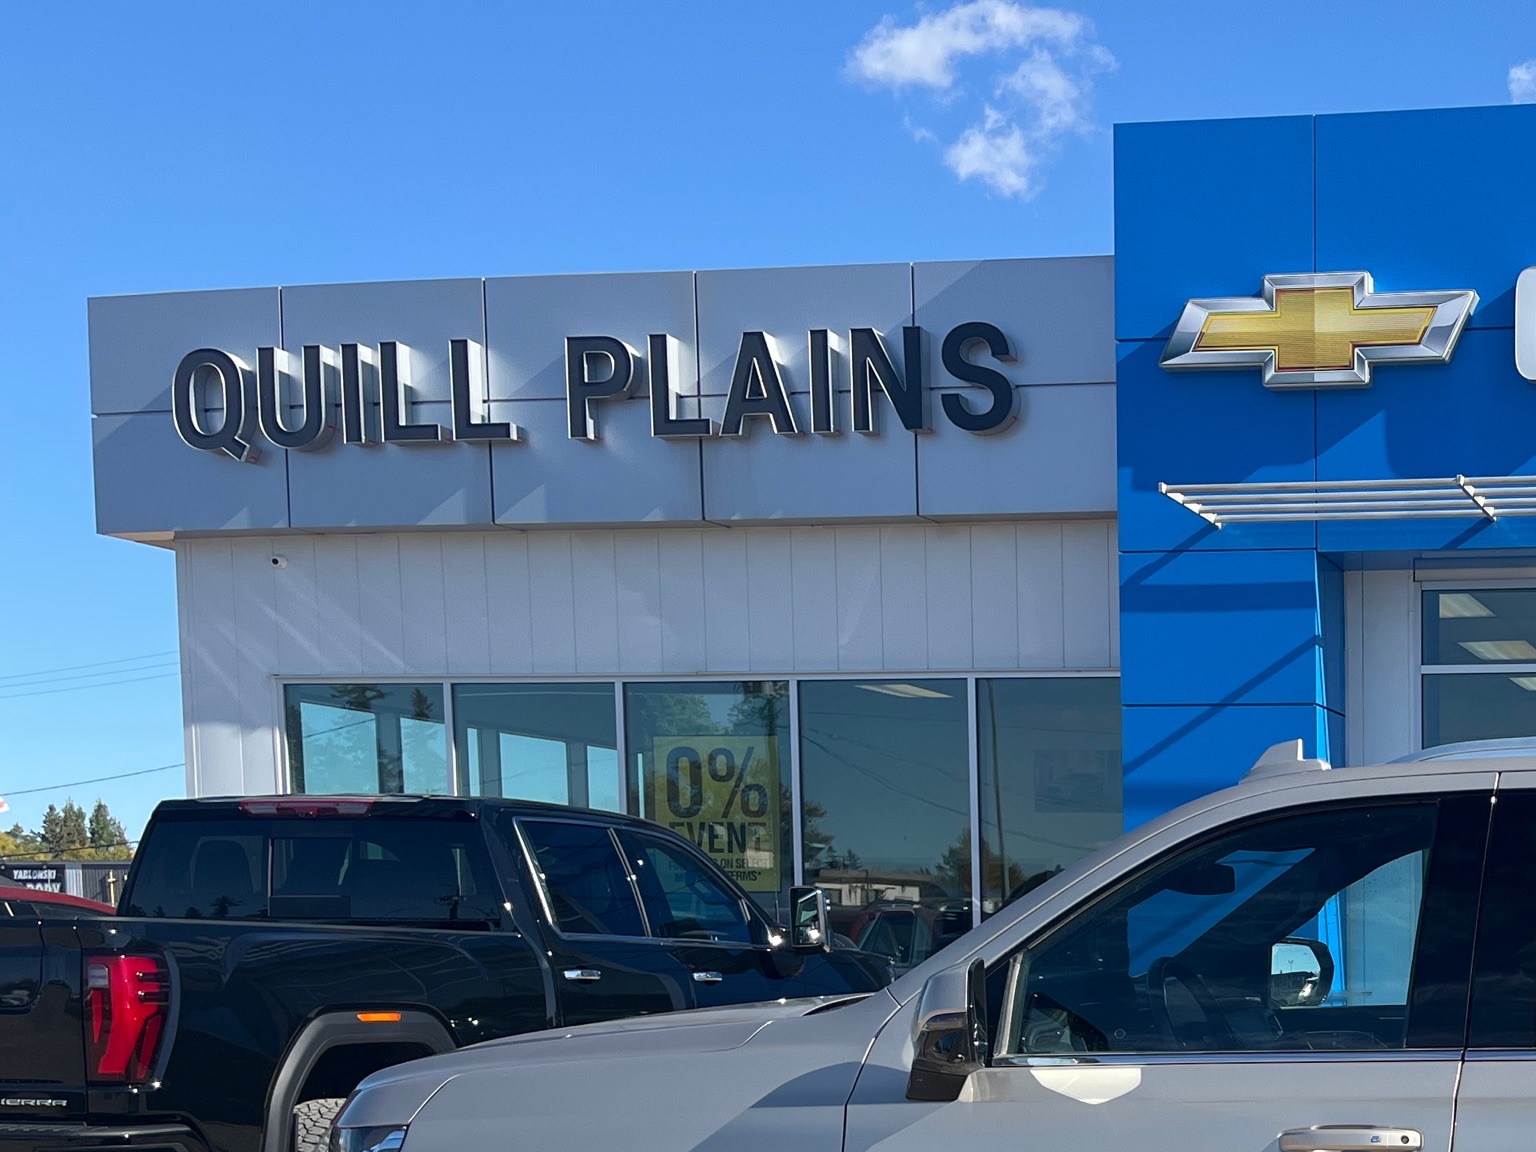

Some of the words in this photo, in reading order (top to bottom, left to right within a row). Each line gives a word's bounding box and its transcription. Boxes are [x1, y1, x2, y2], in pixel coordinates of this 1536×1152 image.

[171, 337, 526, 463] QUILL
[565, 320, 1019, 439] PLAINS
[666, 746, 769, 818] 0%
[0, 1098, 68, 1107] IERRA
